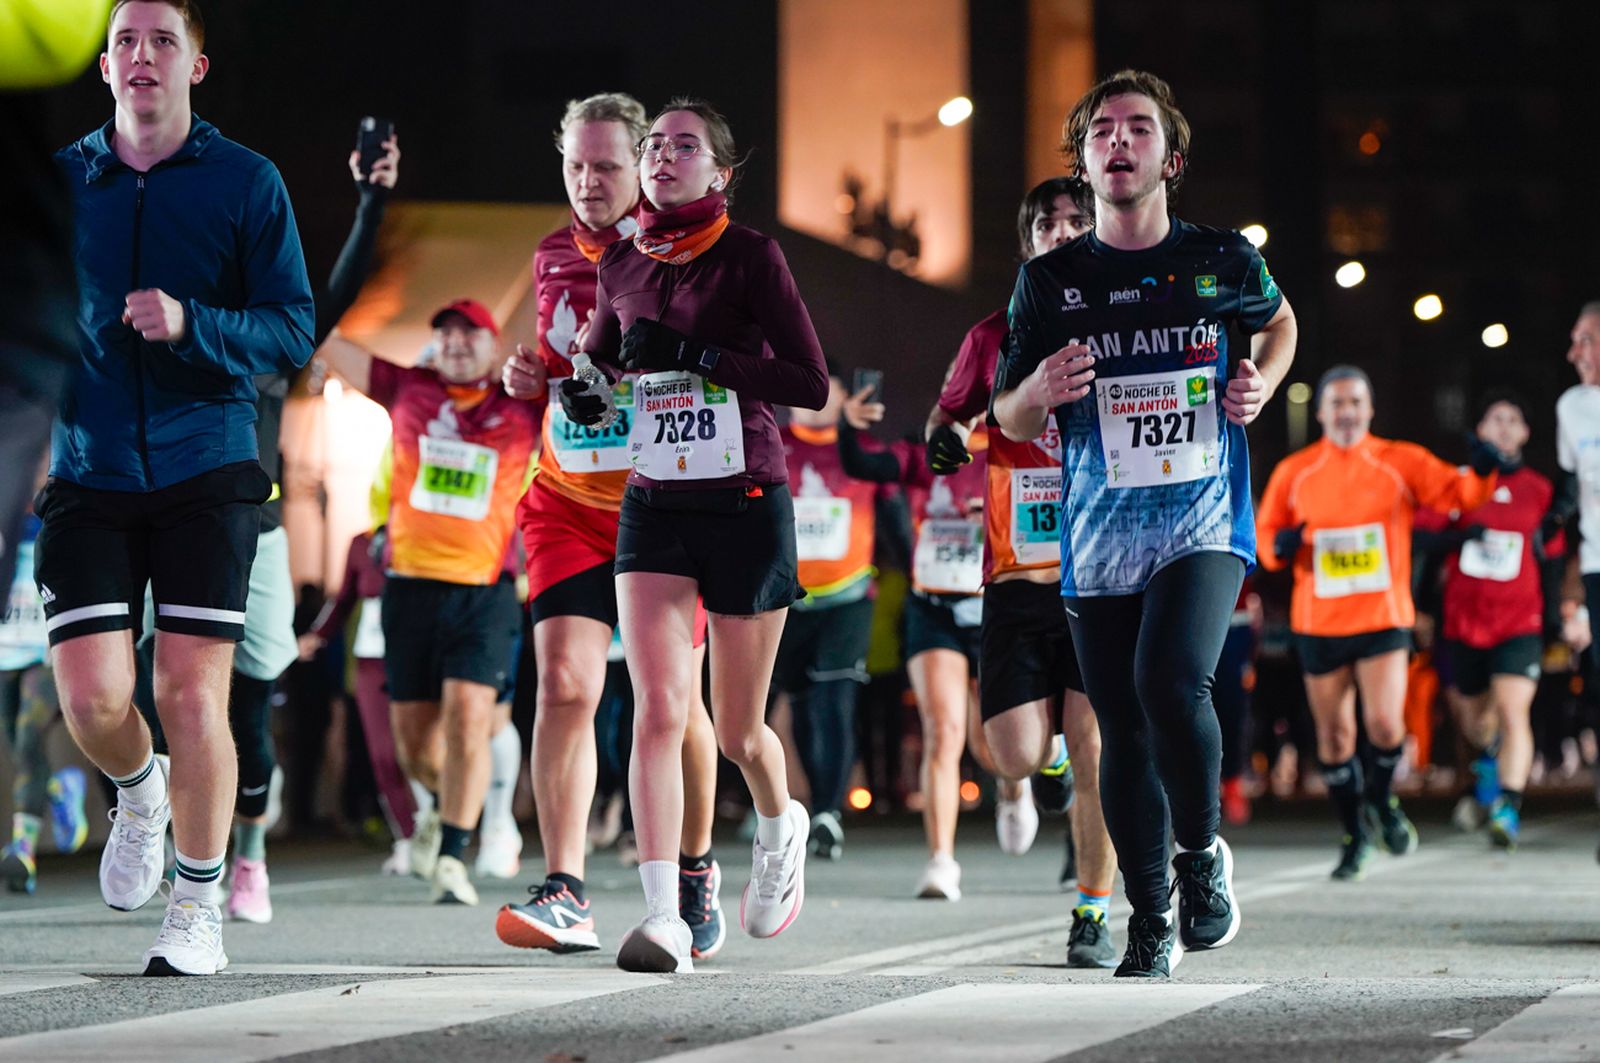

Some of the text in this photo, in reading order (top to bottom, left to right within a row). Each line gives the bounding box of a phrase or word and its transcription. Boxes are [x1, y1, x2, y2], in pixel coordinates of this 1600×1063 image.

[1109, 287, 1140, 304] jaén
[1069, 318, 1218, 361] AN ANTÓN
[1184, 341, 1219, 364] 2025
[653, 382, 692, 396] NOCHE DE
[1124, 386, 1160, 399] NOCHE
[1163, 384, 1176, 396] DE
[646, 400, 661, 412] SAN
[662, 394, 693, 410] ANTÓN
[1112, 402, 1135, 415] SAN
[1138, 395, 1178, 412] ANTÓN
[653, 408, 716, 444] 7328
[1126, 410, 1196, 448] 7327
[1154, 449, 1176, 457] Javier
[1022, 492, 1040, 502] SAN
